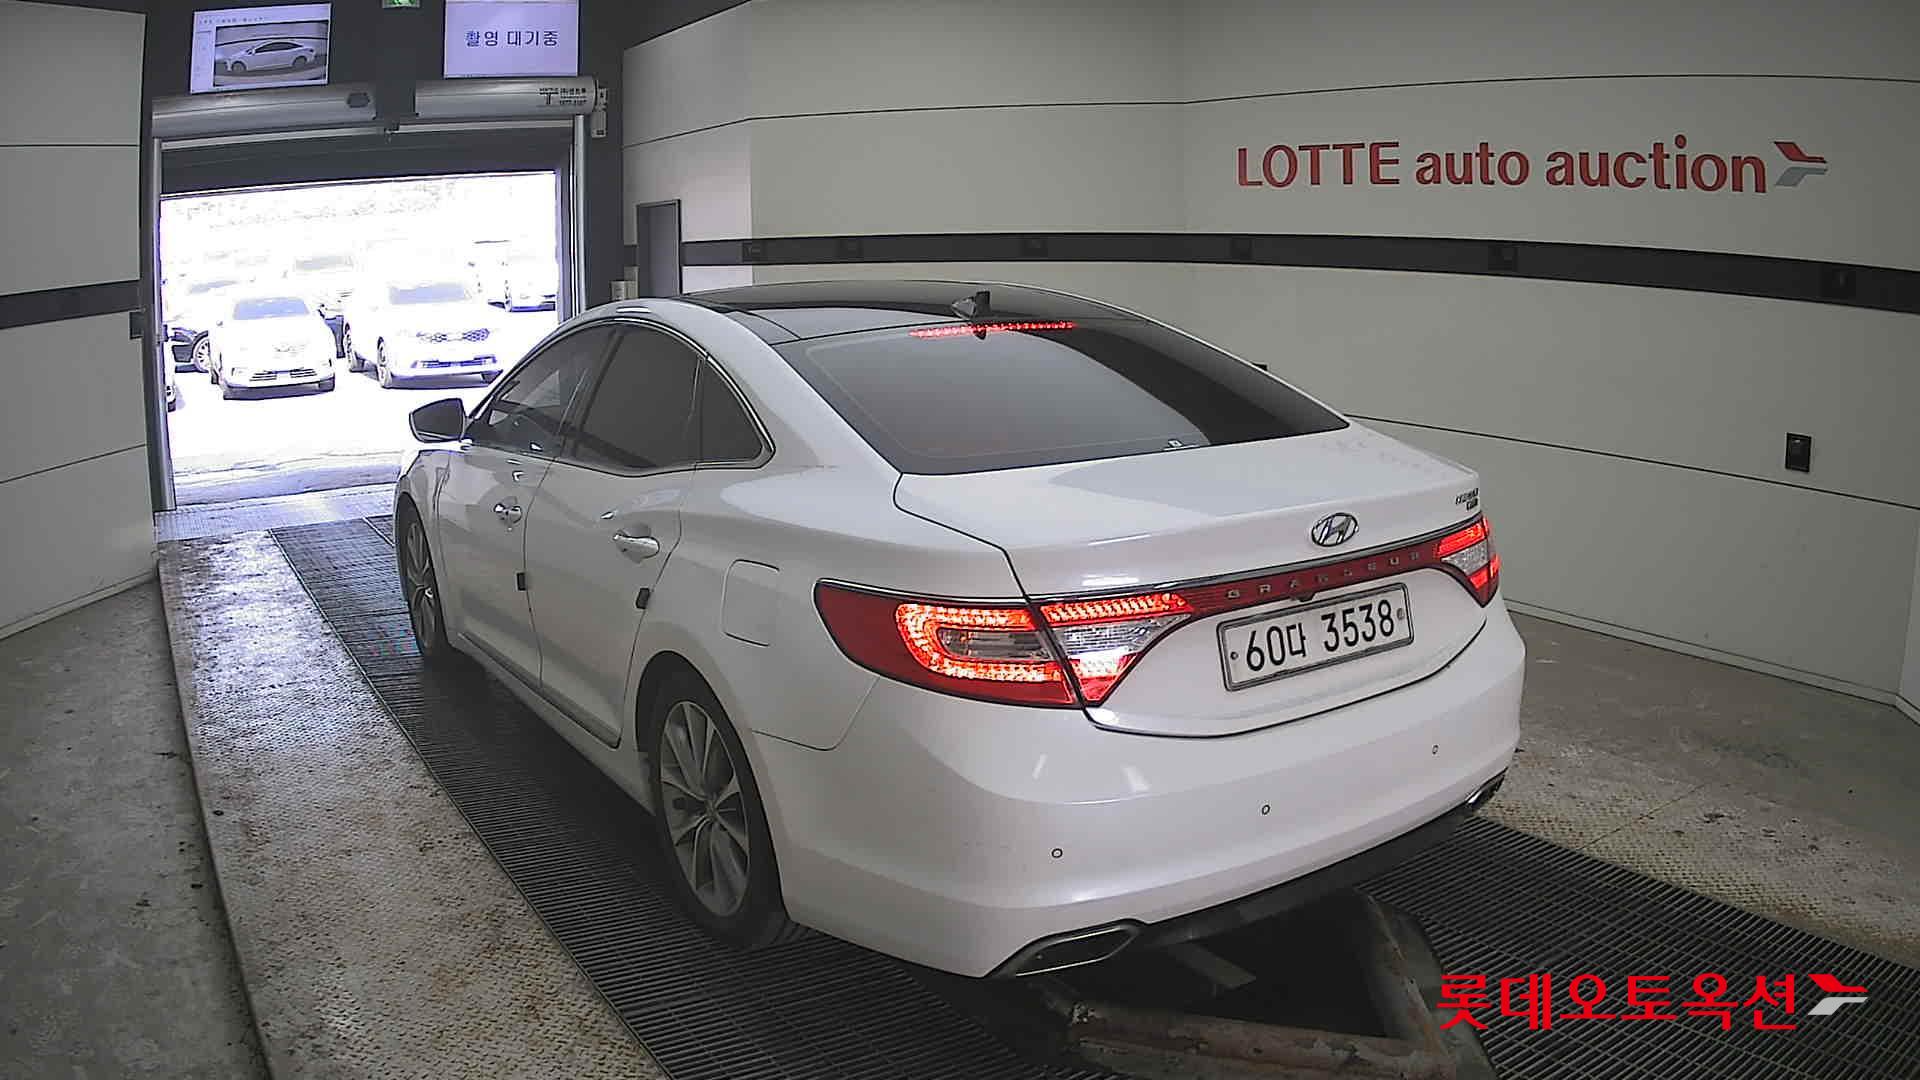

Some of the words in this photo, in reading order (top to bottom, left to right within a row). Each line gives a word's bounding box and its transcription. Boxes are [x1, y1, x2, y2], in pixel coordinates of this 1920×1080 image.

[465, 30, 498, 47] 촬영
[506, 30, 558, 47] 대기중
[1237, 142, 1400, 187] LOTTE
[1415, 141, 1530, 186] auto
[1545, 134, 1767, 194] auction
[1246, 622, 1307, 671] 60다
[1321, 599, 1394, 652] 3538
